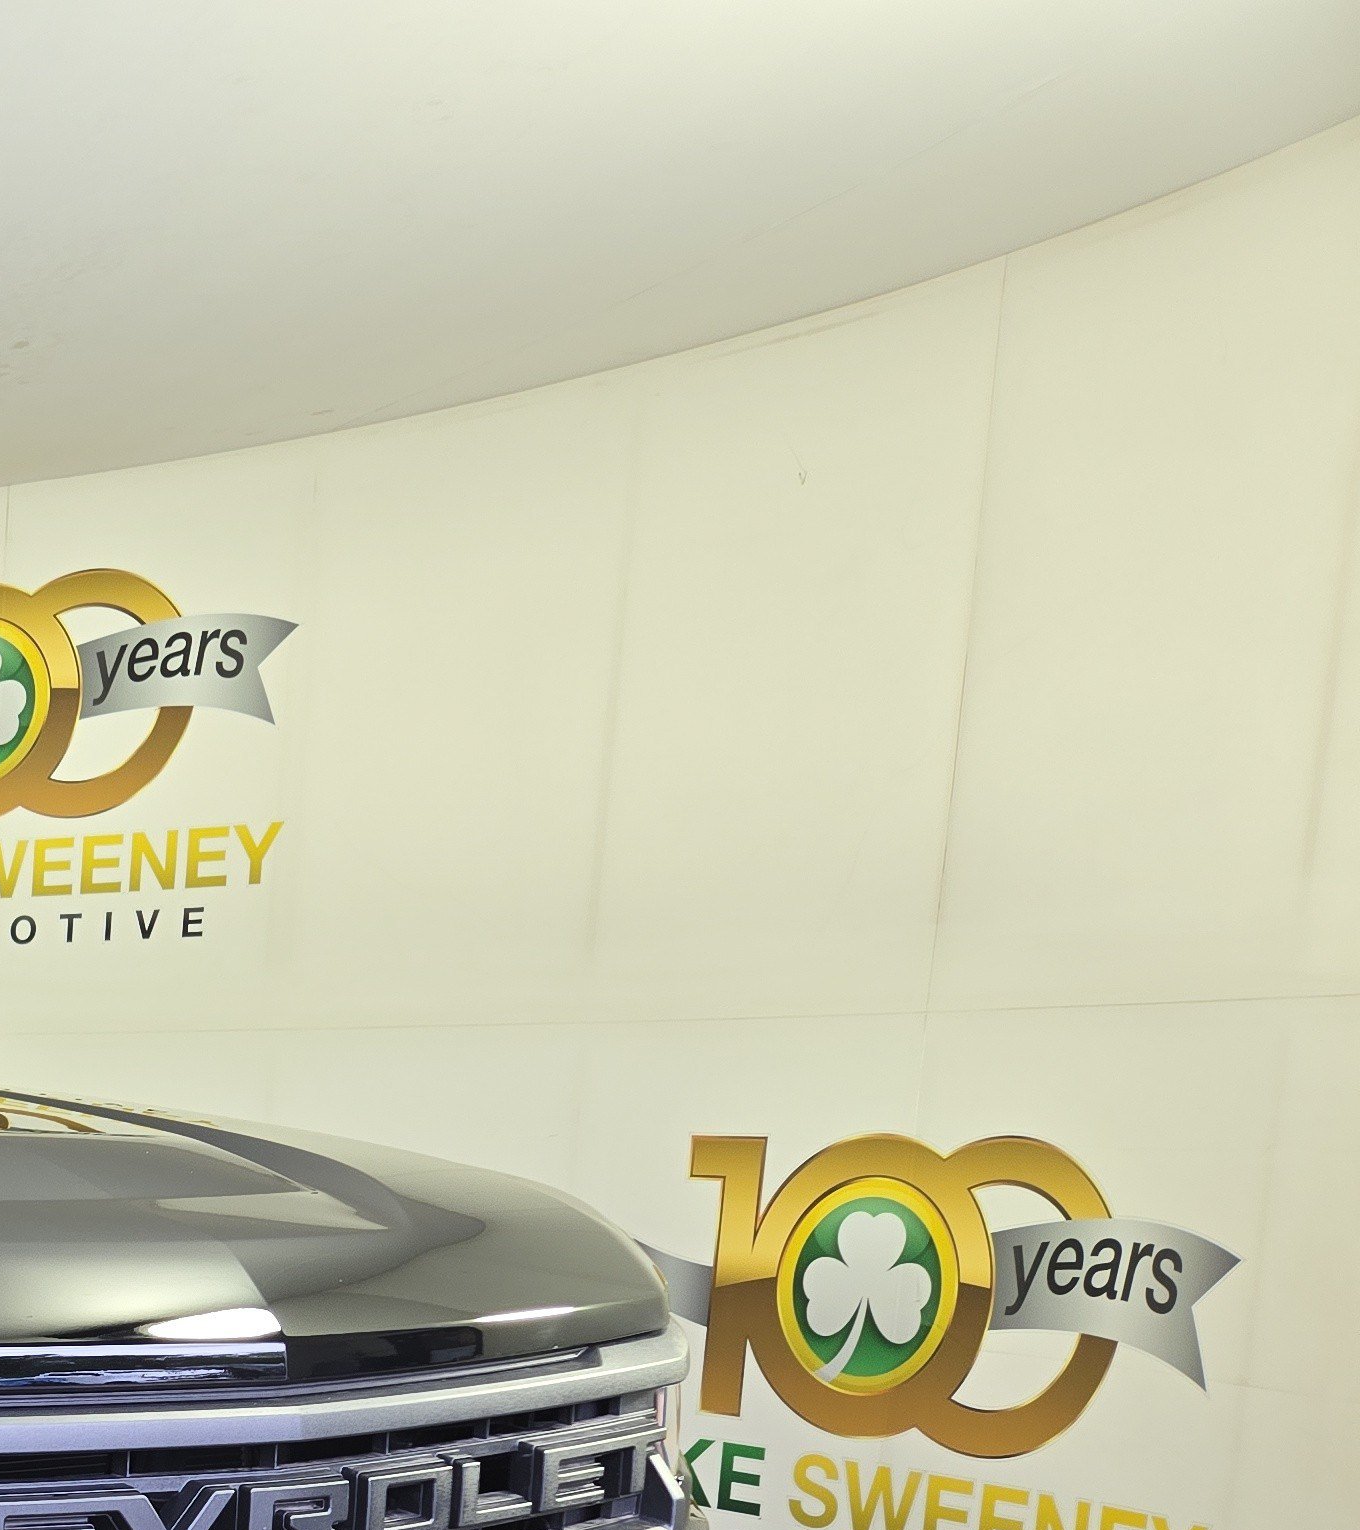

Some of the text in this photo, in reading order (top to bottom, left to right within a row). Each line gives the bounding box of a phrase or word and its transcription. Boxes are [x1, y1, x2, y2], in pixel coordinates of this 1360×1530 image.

[92, 626, 249, 707] years
[689, 1133, 1183, 1459] 100 years
[683, 1438, 766, 1517] KE
